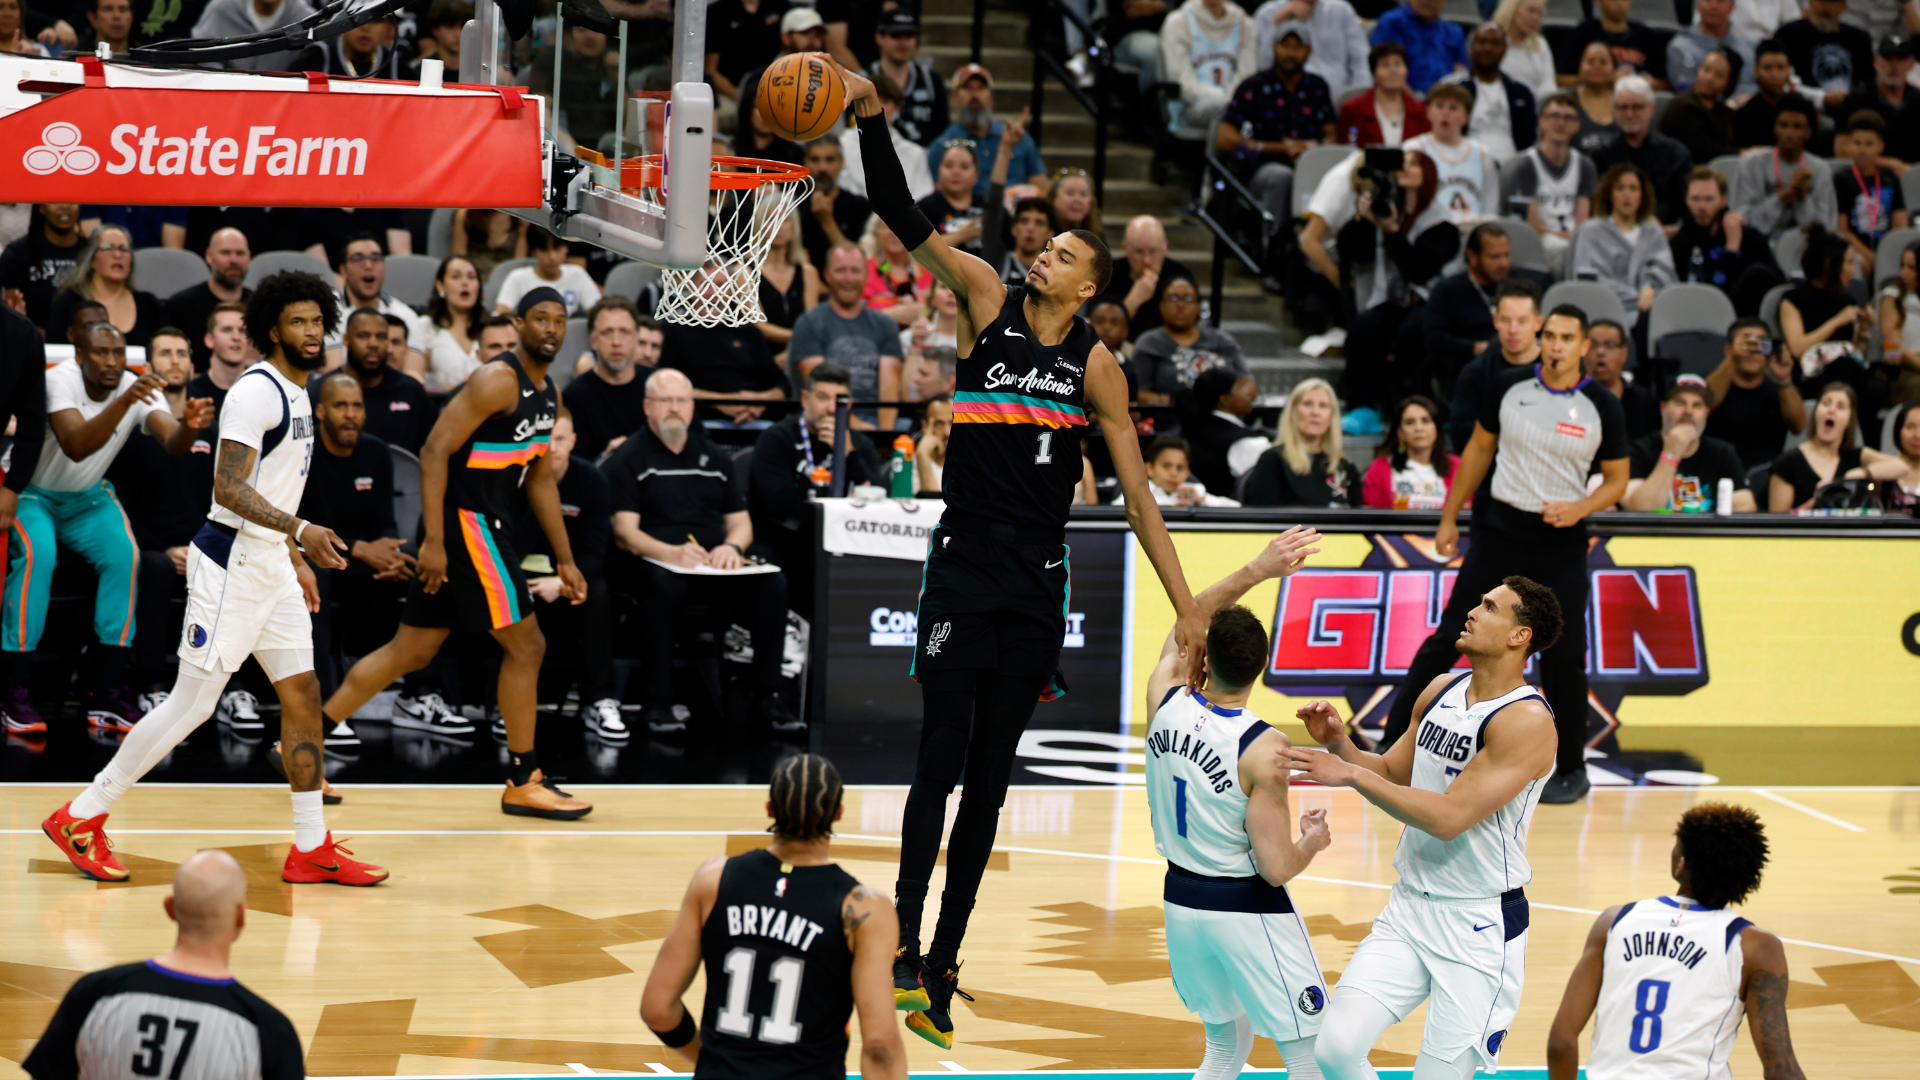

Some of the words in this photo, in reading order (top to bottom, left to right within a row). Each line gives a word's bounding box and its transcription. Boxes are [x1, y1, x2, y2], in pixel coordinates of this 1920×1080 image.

[802, 60, 824, 114] Wilson
[984, 362, 1018, 390] San
[1018, 367, 1076, 396] Antonio
[1035, 432, 1053, 465] 1
[1148, 729, 1233, 794] POULAKIDAS
[1417, 719, 1474, 762] DALLAS
[1173, 775, 1188, 839] 1
[727, 904, 824, 952] BRYANT
[1623, 931, 1707, 970] JOHNSON
[715, 946, 805, 1044] 11
[1629, 978, 1671, 1054] 8
[131, 1013, 200, 1080] 37
